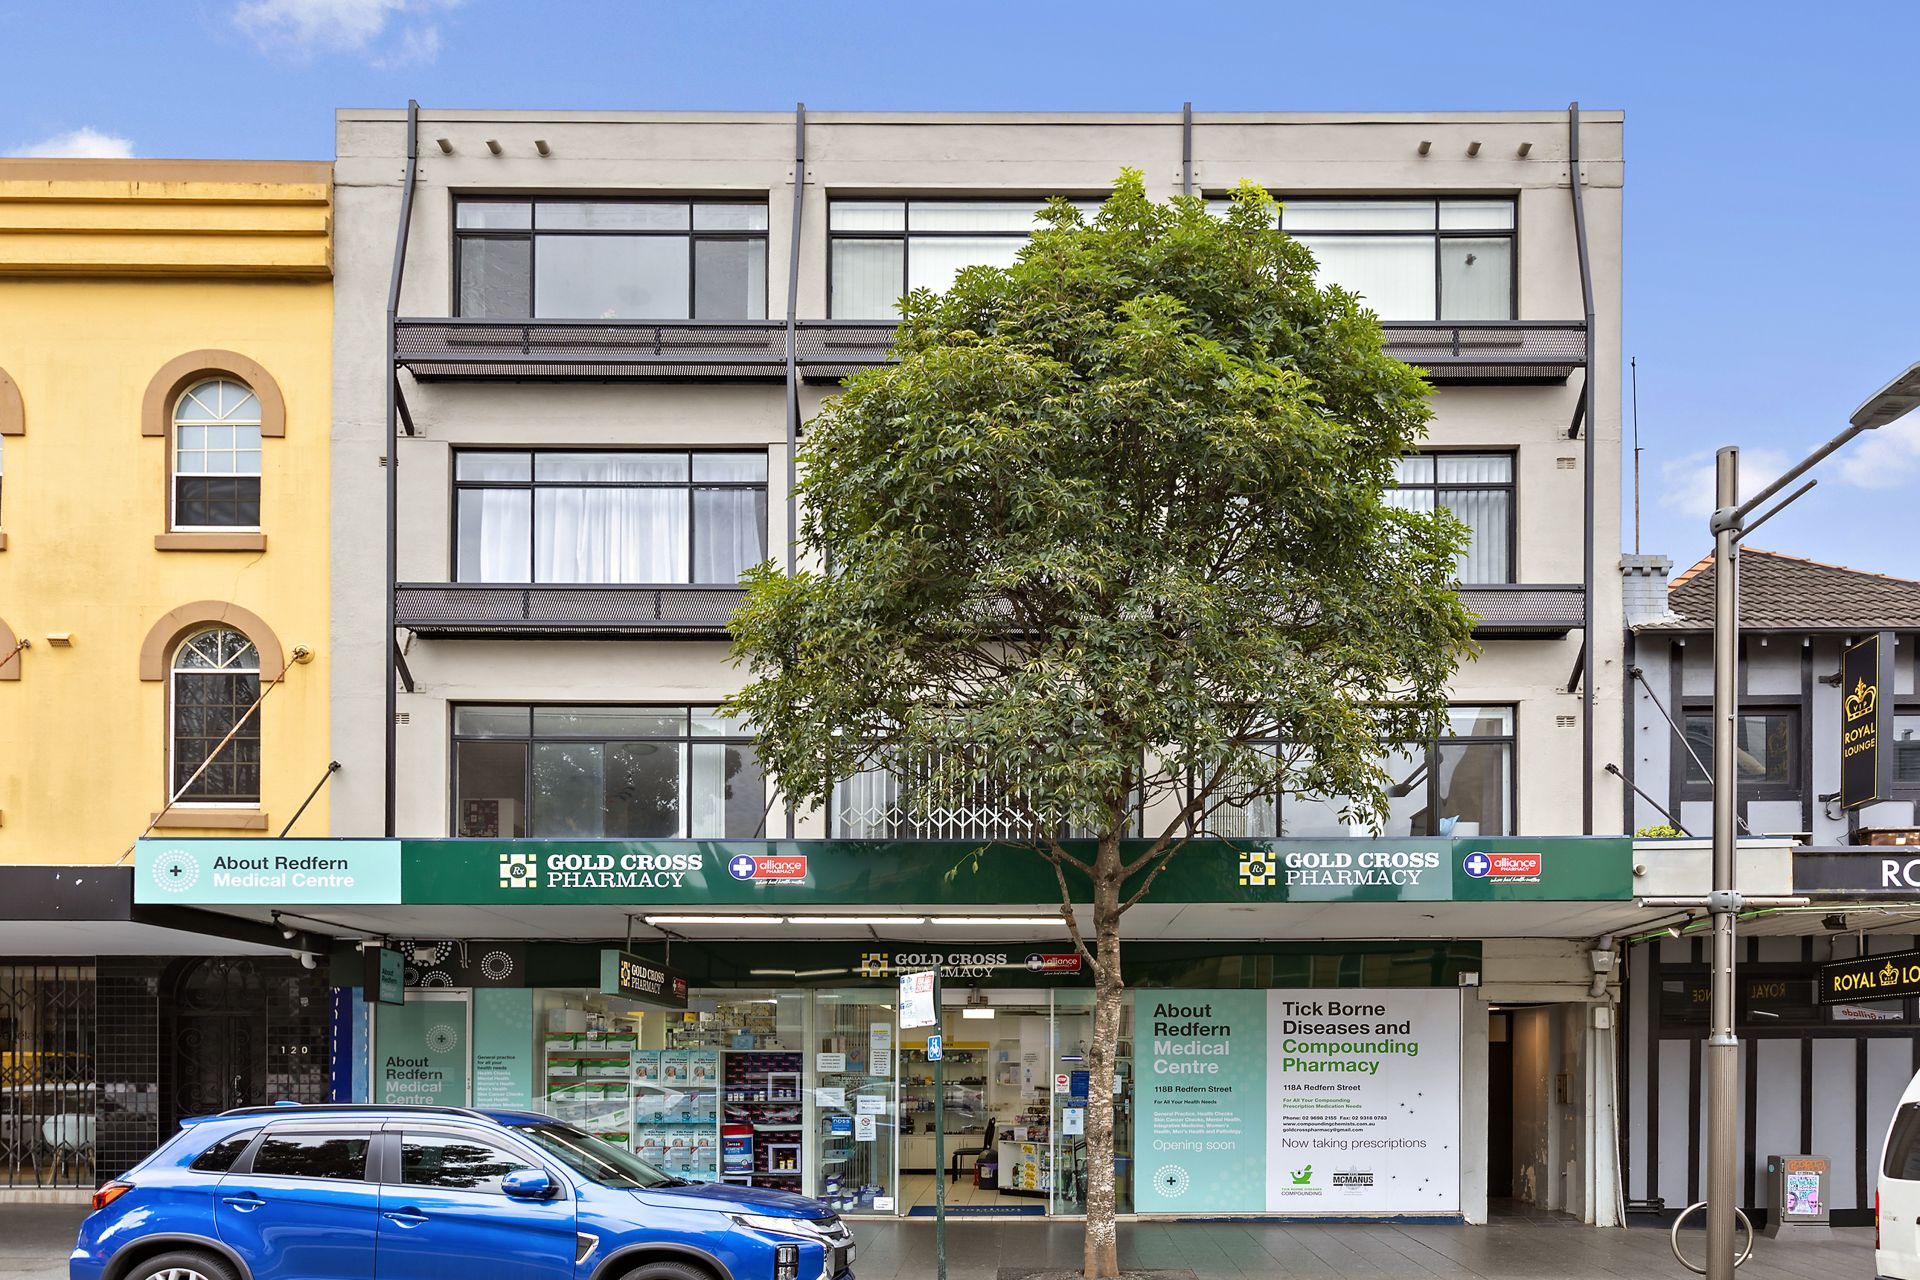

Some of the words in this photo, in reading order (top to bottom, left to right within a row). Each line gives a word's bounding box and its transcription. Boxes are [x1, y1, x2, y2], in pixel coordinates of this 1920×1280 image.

[1853, 702, 1867, 711] VIP
[1845, 722, 1875, 744] ROYAL
[1845, 738, 1875, 758] LOUNGE
[213, 856, 269, 870] About
[275, 856, 348, 870] Redfern
[547, 854, 616, 871] GOLD
[620, 854, 703, 871] CROSS
[759, 860, 801, 870] alliance
[1285, 853, 1352, 869] GOLD
[1357, 853, 1439, 869] CROSS
[1494, 857, 1536, 868] alliance
[214, 873, 291, 887] Medical
[300, 873, 355, 887] Centre
[547, 872, 685, 888] PHARMACY
[1285, 870, 1422, 885] PHARMACY
[1882, 859, 1920, 887] RO
[895, 953, 943, 965] GOLD
[948, 953, 1007, 965] CROSS
[1046, 957, 1078, 965] alliance
[632, 964, 647, 979] GOLD
[647, 968, 665, 984] CROSS
[1834, 971, 1877, 992] ROYAL
[631, 976, 662, 995] PHARMACY
[1153, 1003, 1212, 1018] About
[1282, 1001, 1323, 1016] Tick
[1328, 1001, 1386, 1016] Borne
[1154, 1022, 1231, 1037] Redfern
[1283, 1020, 1370, 1035] Diseases
[1374, 1020, 1411, 1035] and
[281, 1046, 308, 1054] 120
[1154, 1040, 1230, 1055] Medical
[1282, 1039, 1419, 1057] Compounding
[386, 1056, 429, 1067] About
[1153, 1059, 1219, 1074] Centre
[1283, 1057, 1380, 1075] Pharmacy
[386, 1068, 443, 1080] Redfern
[386, 1081, 442, 1093] Medical
[386, 1093, 434, 1105] Centre
[1153, 1139, 1203, 1153] Opening
[1206, 1141, 1235, 1151] soon
[1282, 1138, 1309, 1148] Now
[1313, 1138, 1348, 1151] taking
[1351, 1138, 1427, 1151] prescriptions
